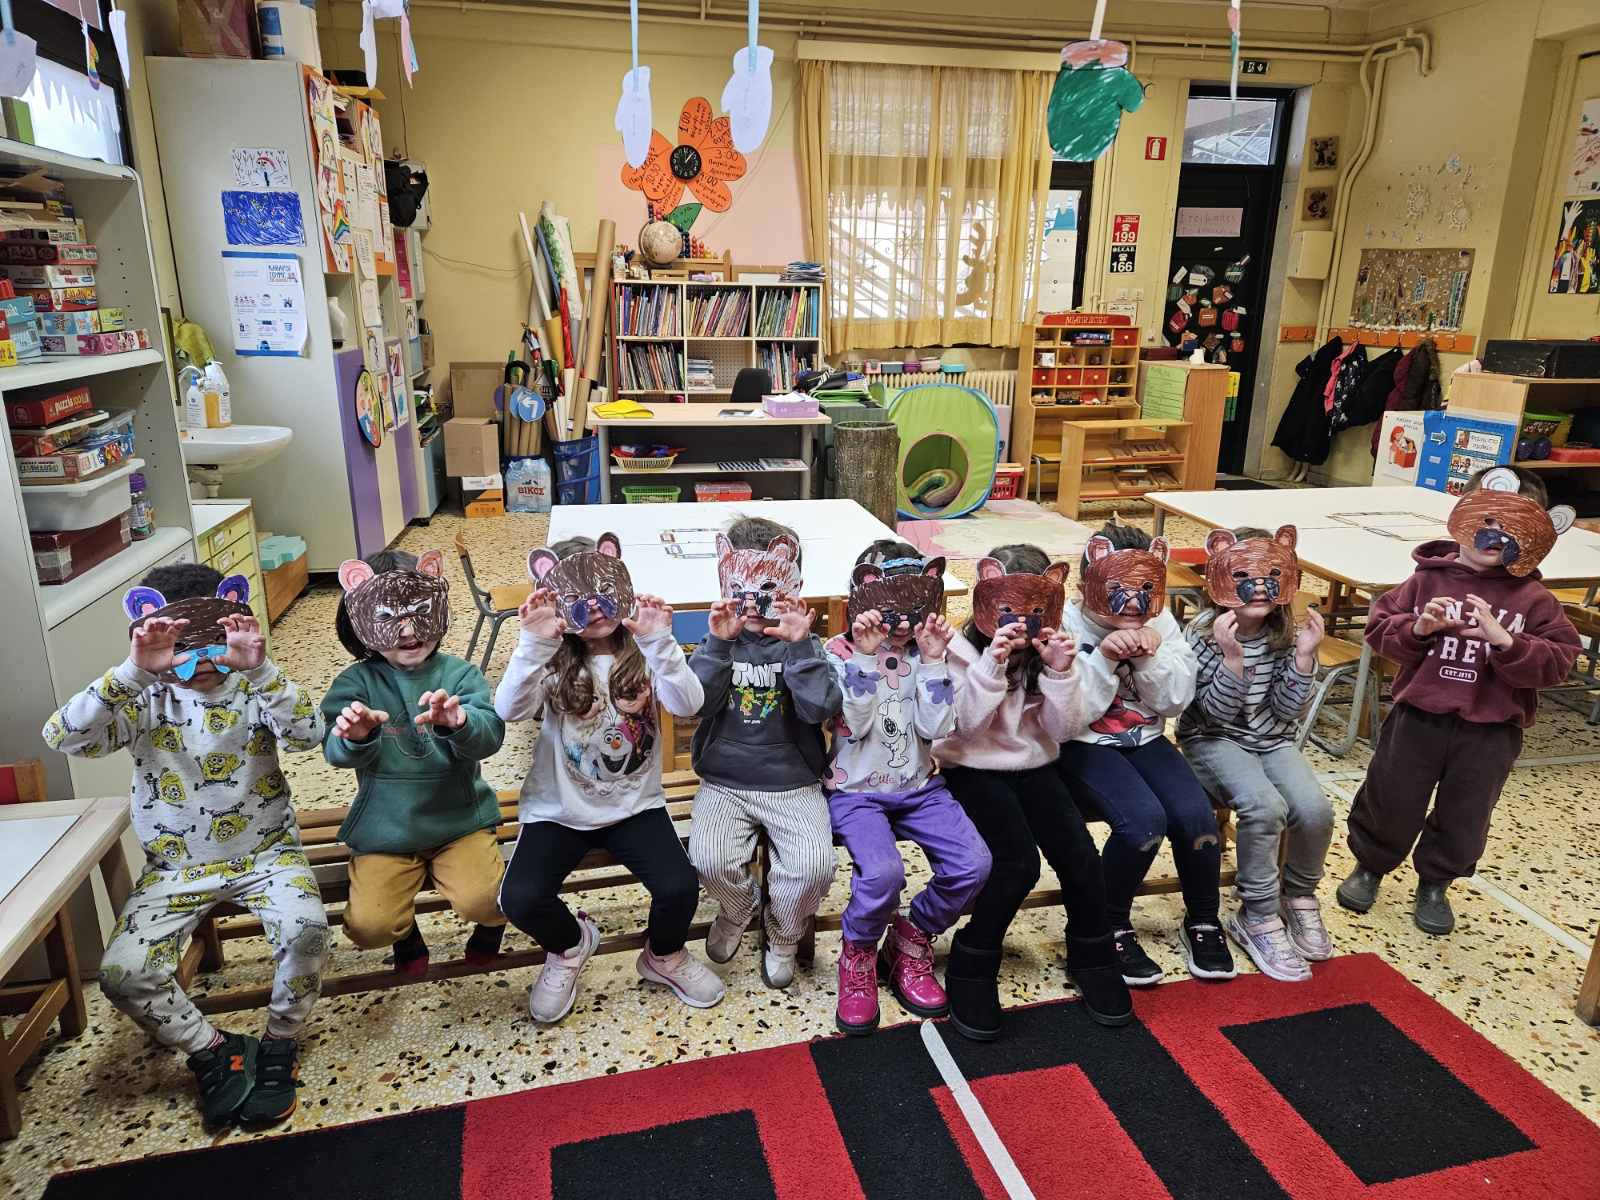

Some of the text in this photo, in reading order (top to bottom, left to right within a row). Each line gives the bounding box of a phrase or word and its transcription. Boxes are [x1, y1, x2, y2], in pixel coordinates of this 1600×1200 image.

[714, 149, 738, 161] 3:00
[1115, 231, 1136, 242] 199
[1112, 261, 1133, 272] 166
[731, 661, 783, 688] TMNT
